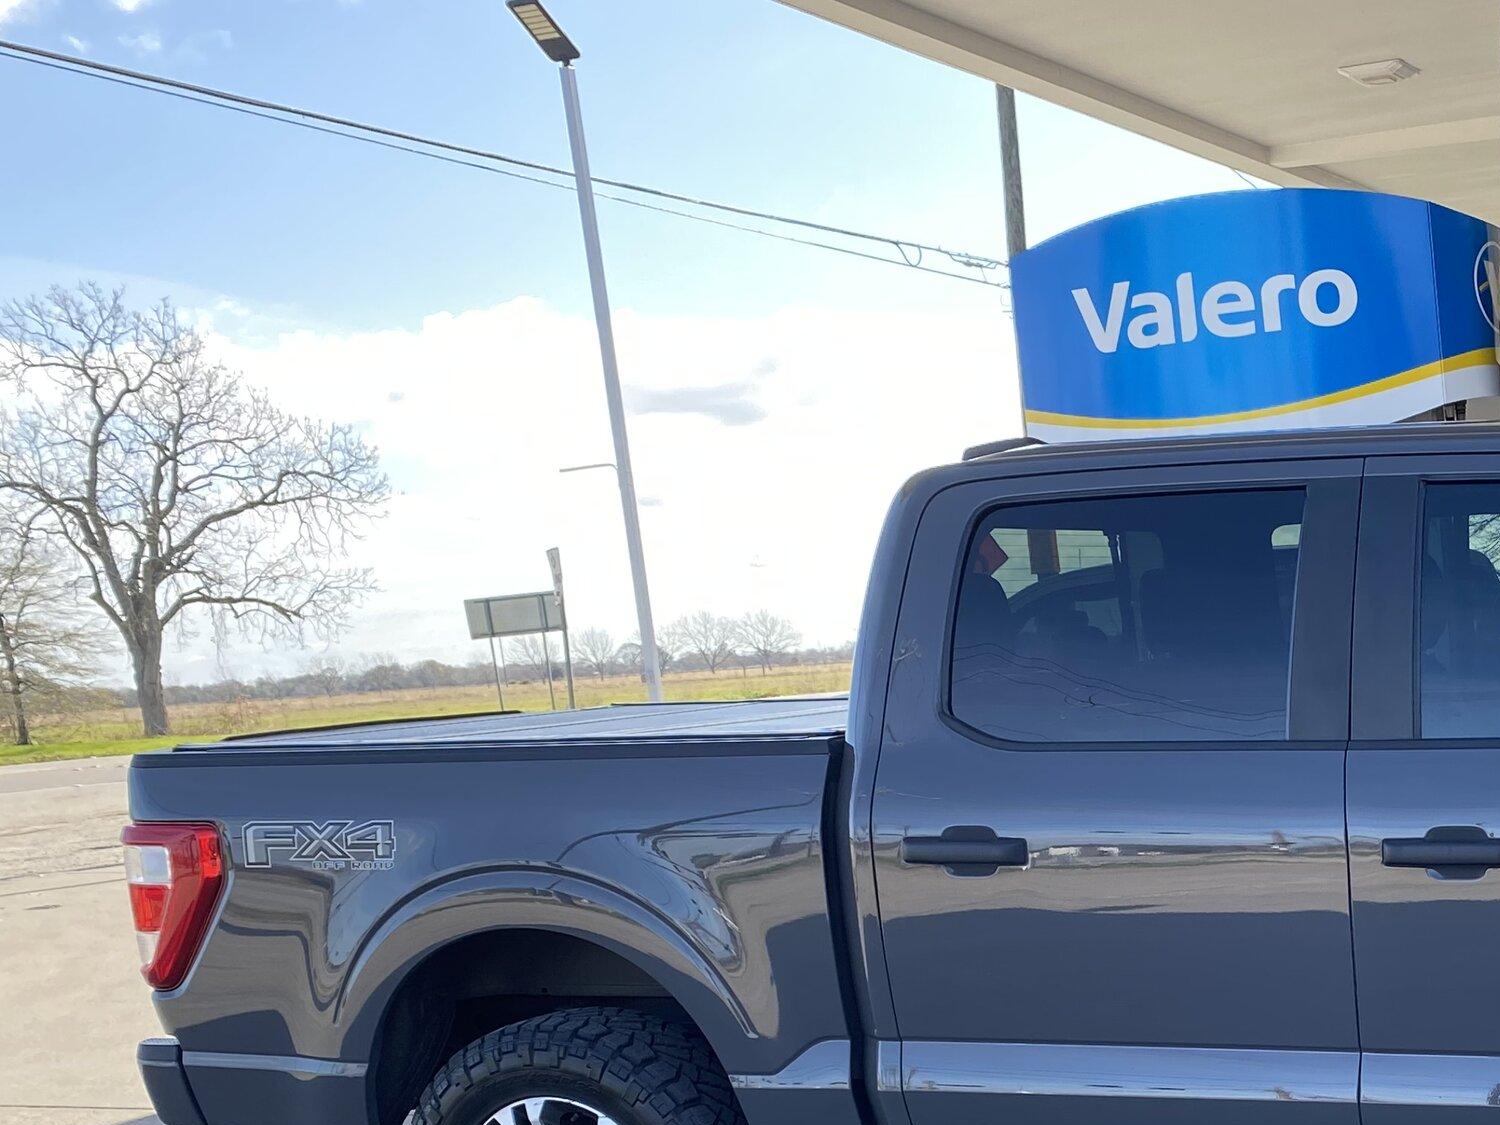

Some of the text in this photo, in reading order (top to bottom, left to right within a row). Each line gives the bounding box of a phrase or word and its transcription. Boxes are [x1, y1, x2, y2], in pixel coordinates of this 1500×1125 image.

[1071, 268, 1359, 354] Valero
[241, 820, 397, 868] FX4
[312, 860, 394, 870] OFF ROAD
